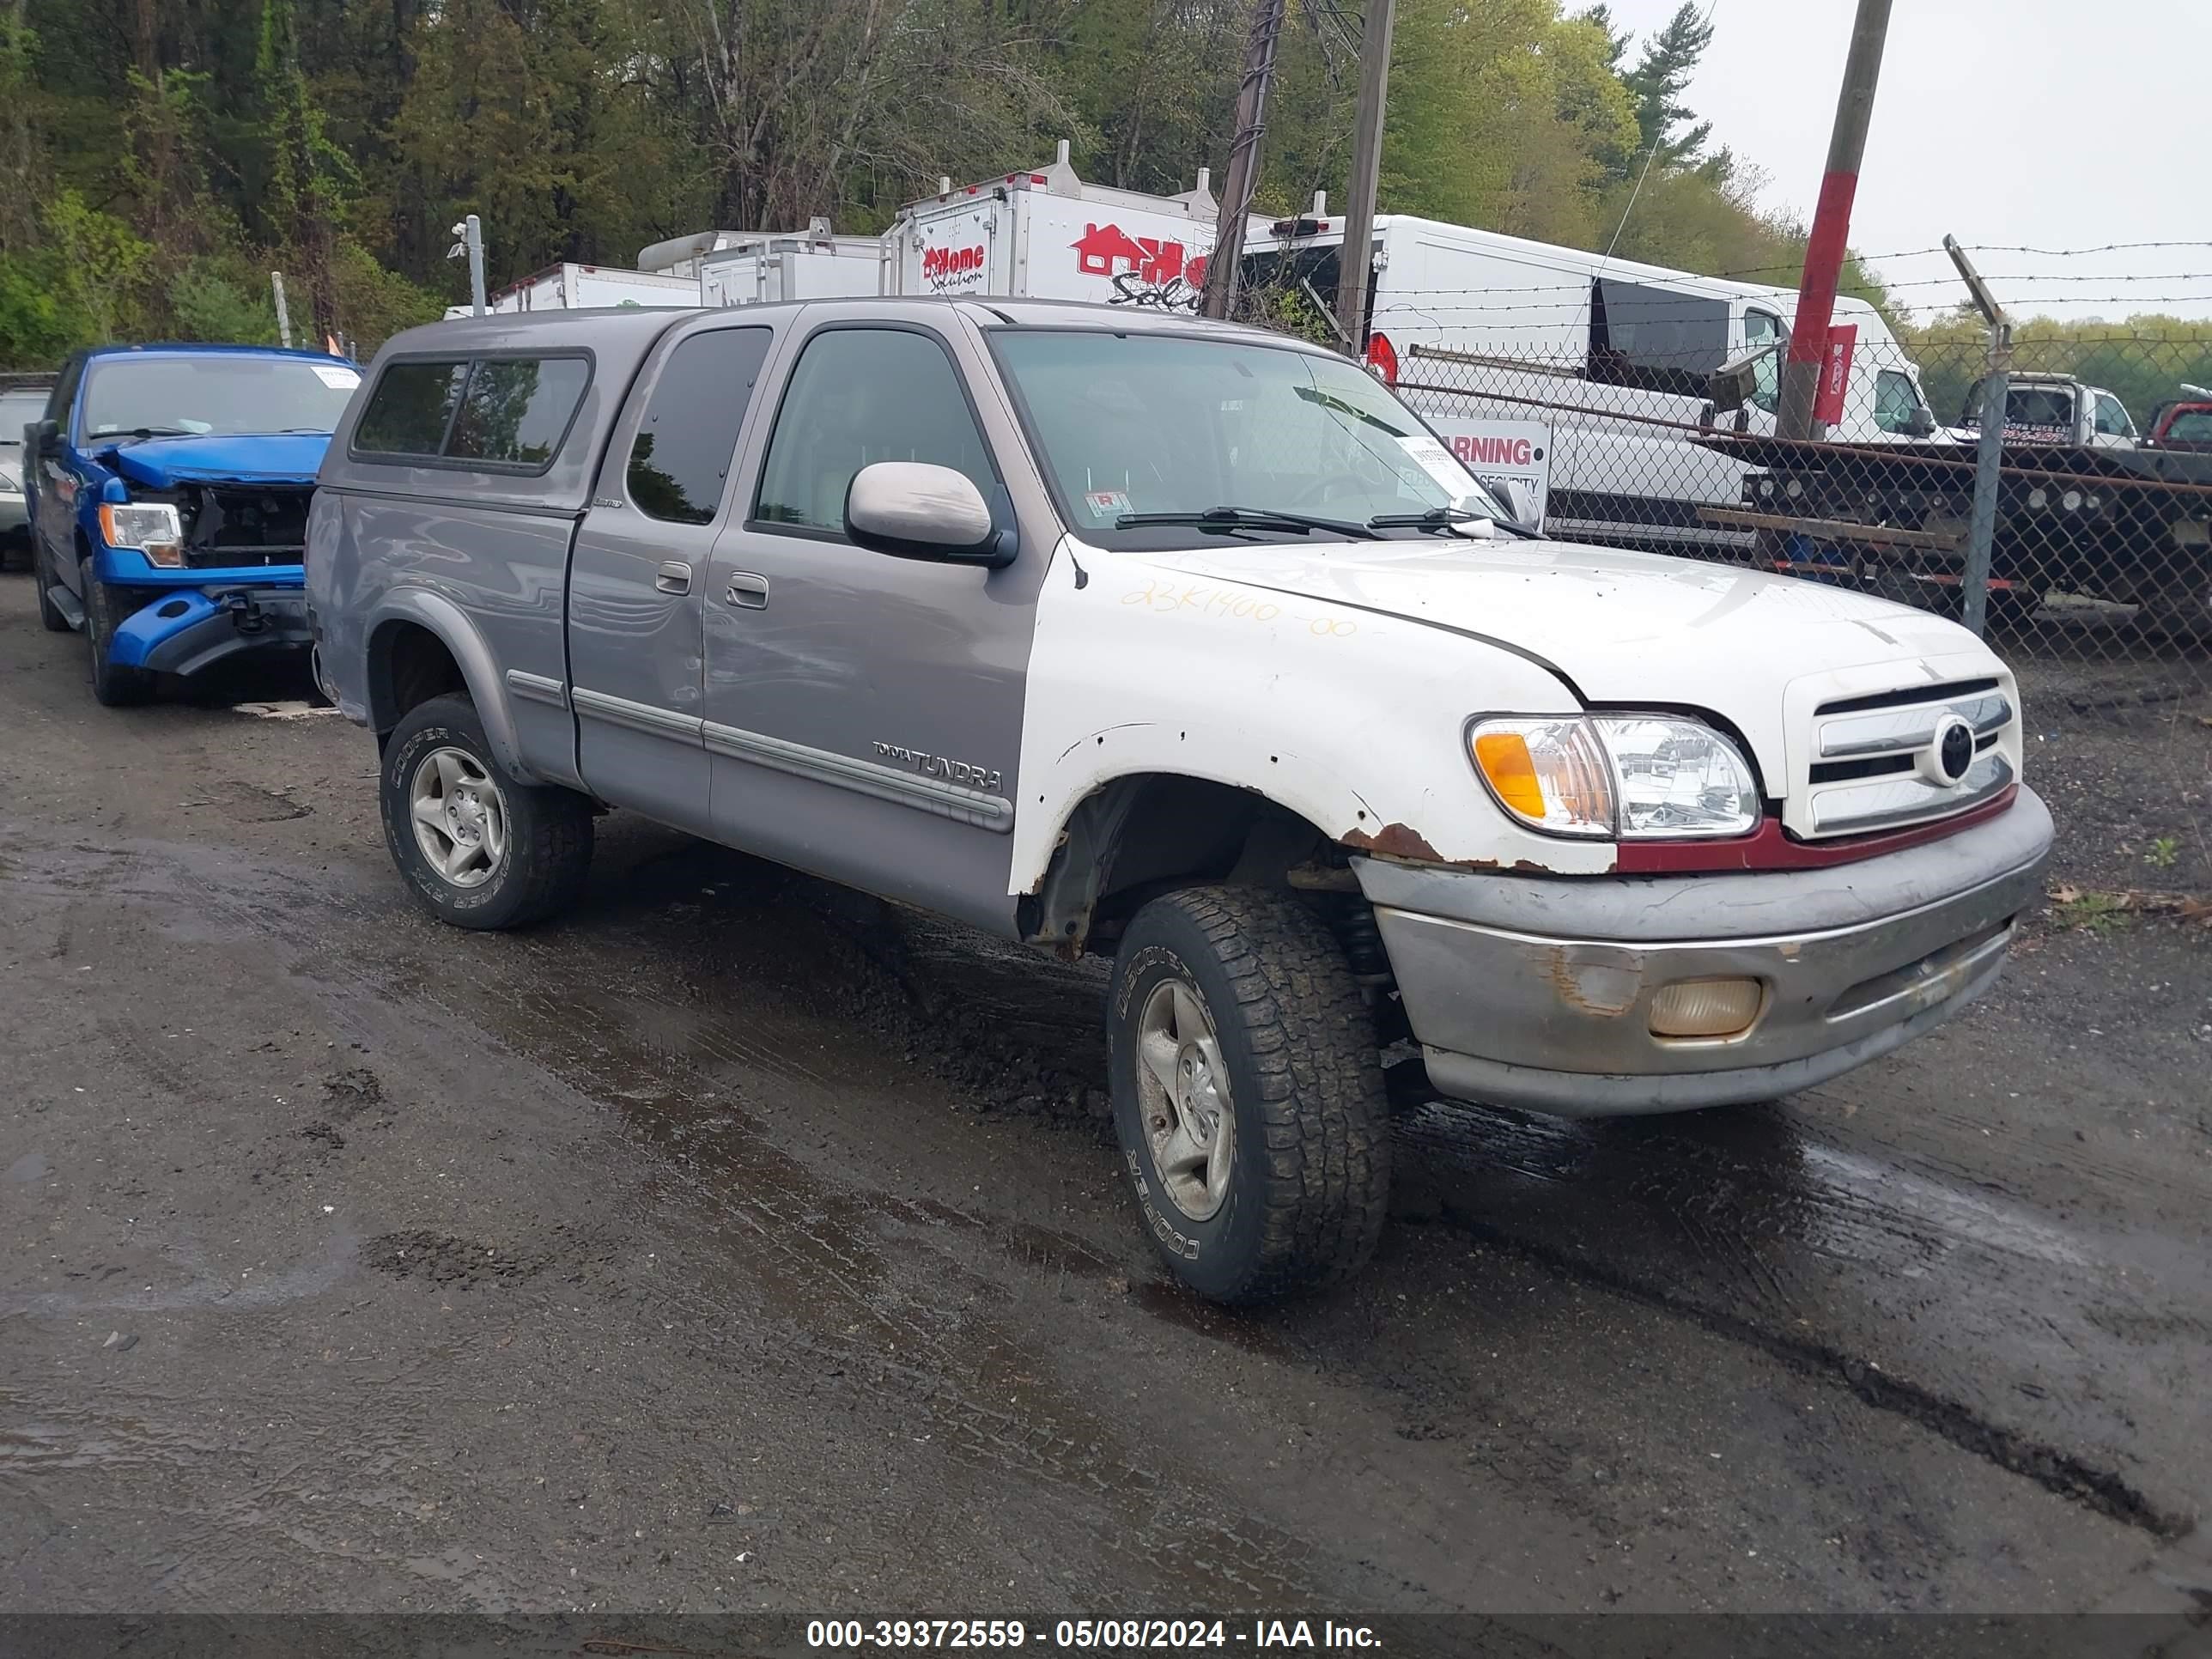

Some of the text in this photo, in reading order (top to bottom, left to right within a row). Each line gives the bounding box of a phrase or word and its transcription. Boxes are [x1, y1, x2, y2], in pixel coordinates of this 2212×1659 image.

[938, 245, 984, 276] Home
[930, 269, 984, 293] Solution
[1442, 436, 1531, 465] RNING
[1480, 475, 1540, 495] SETY
[391, 727, 450, 789] COOPER
[872, 741, 1004, 793] TOYOTA TUNDRA
[1126, 1148, 1200, 1261] COOPER
